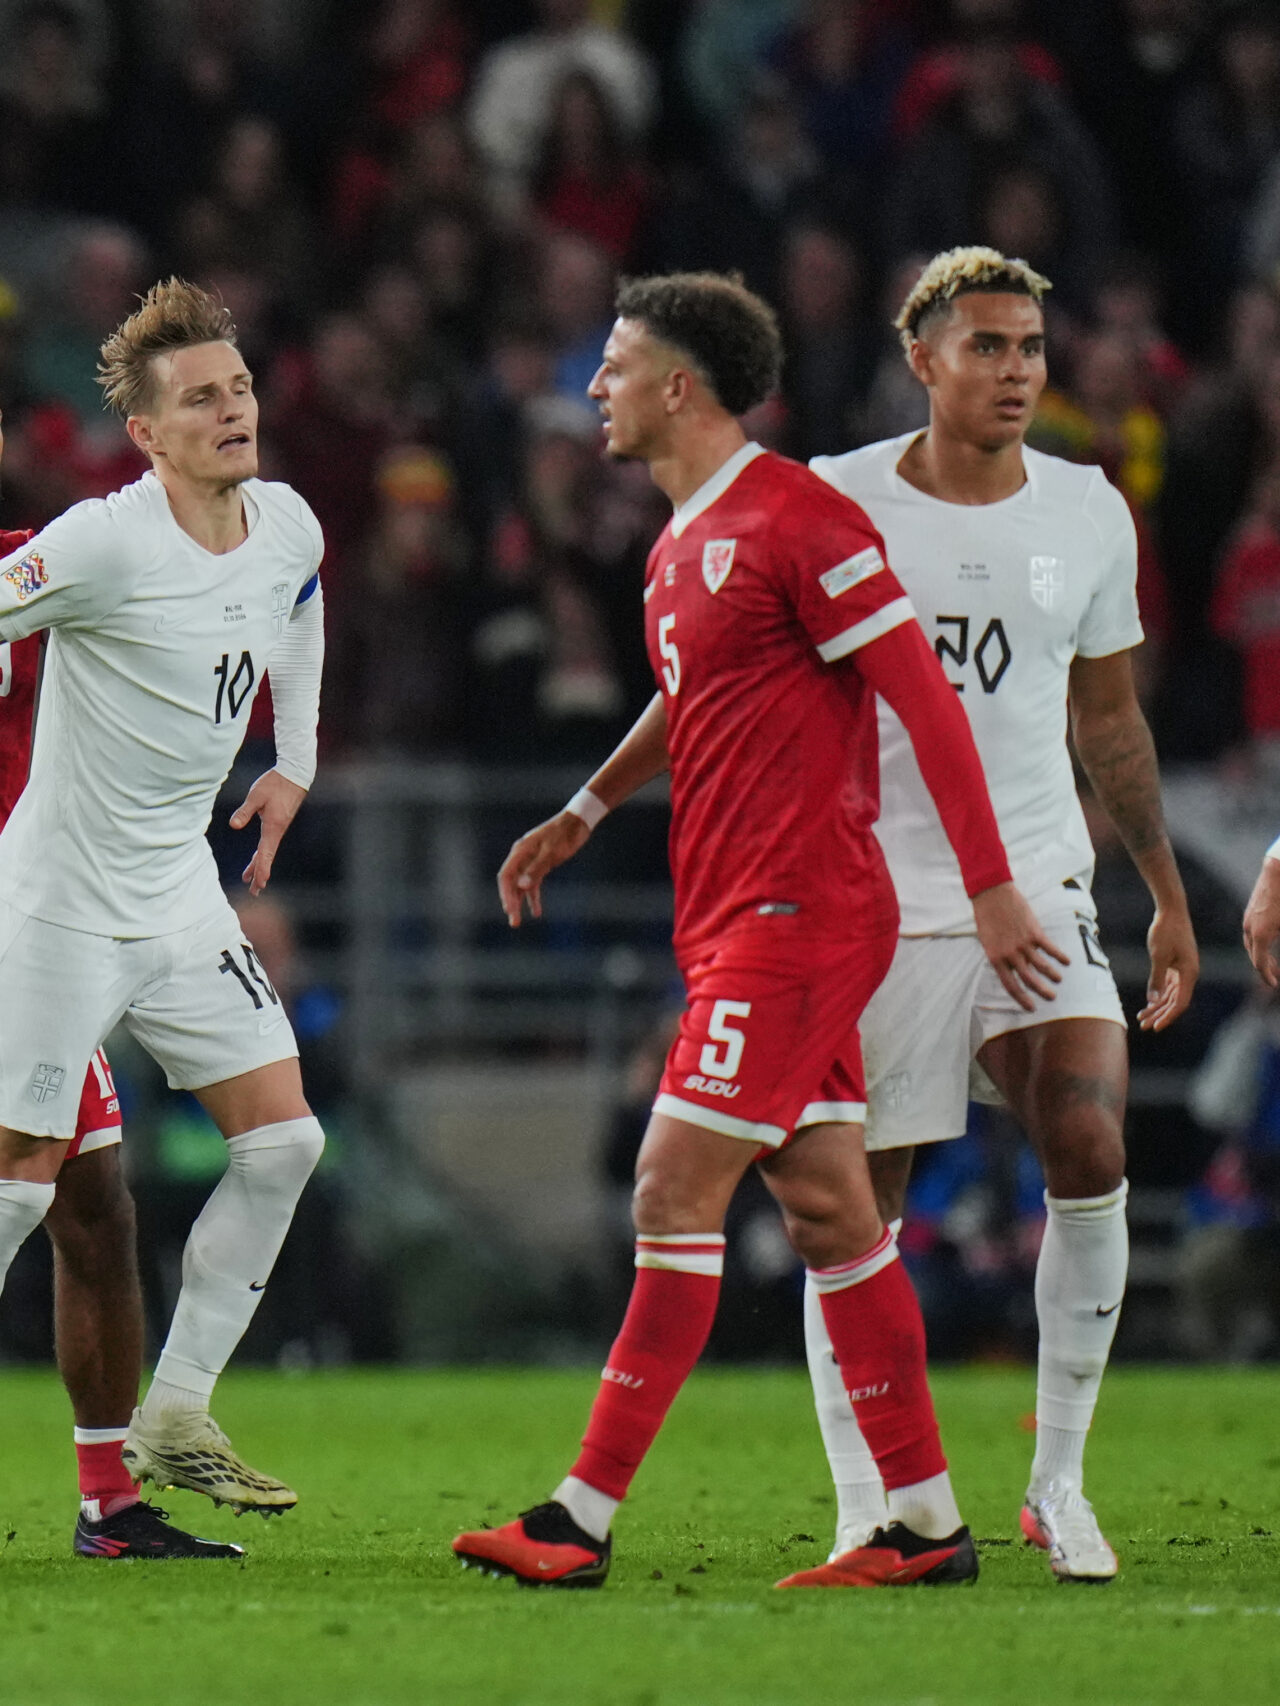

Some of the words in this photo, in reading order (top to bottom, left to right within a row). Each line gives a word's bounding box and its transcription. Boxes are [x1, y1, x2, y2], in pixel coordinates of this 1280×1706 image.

[214, 650, 255, 725] 10
[658, 612, 681, 696] 5
[934, 614, 1012, 694] 20
[698, 998, 752, 1080] 5
[683, 1074, 742, 1099] SUDU
